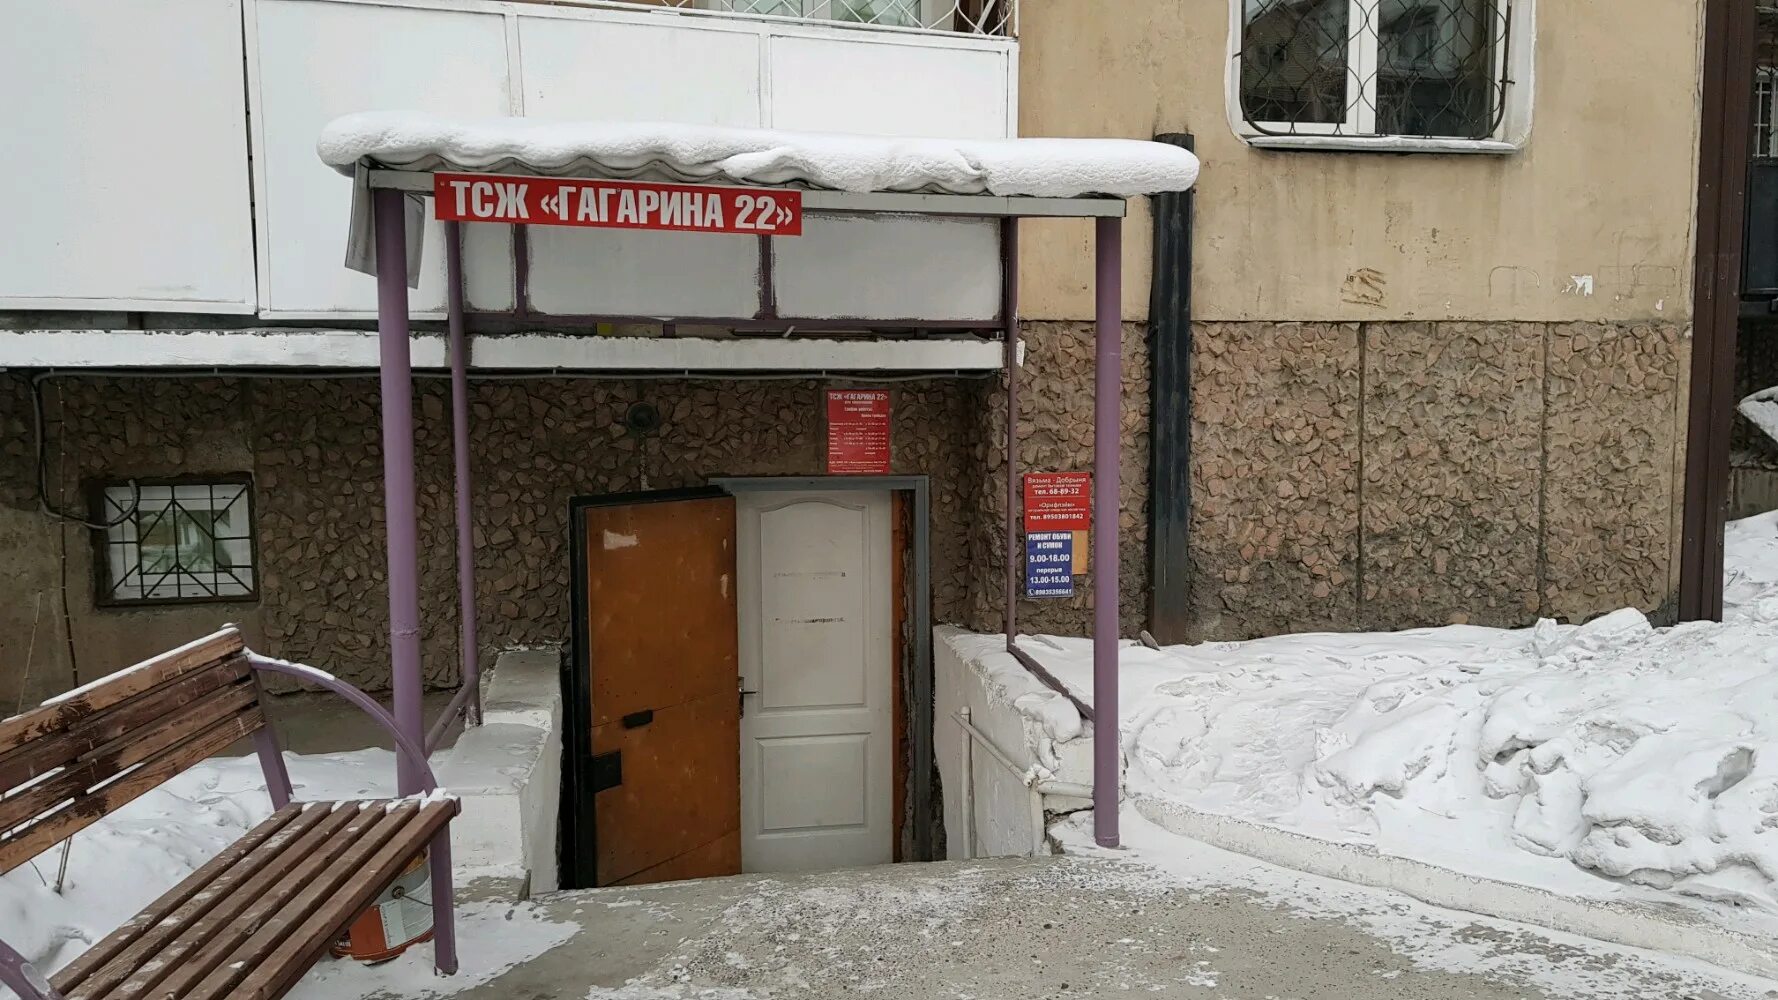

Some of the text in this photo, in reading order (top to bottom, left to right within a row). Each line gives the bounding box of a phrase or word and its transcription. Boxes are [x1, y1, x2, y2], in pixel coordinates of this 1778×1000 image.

[450, 180, 793, 230] ТСЖ «ГАГАРИНА 22»
[1056, 476, 1087, 484] Добрыня
[1028, 533, 1051, 541] РЕМОНТ
[1029, 554, 1070, 563] 9.00-18.00
[1030, 576, 1070, 584] 13.00-15.00
